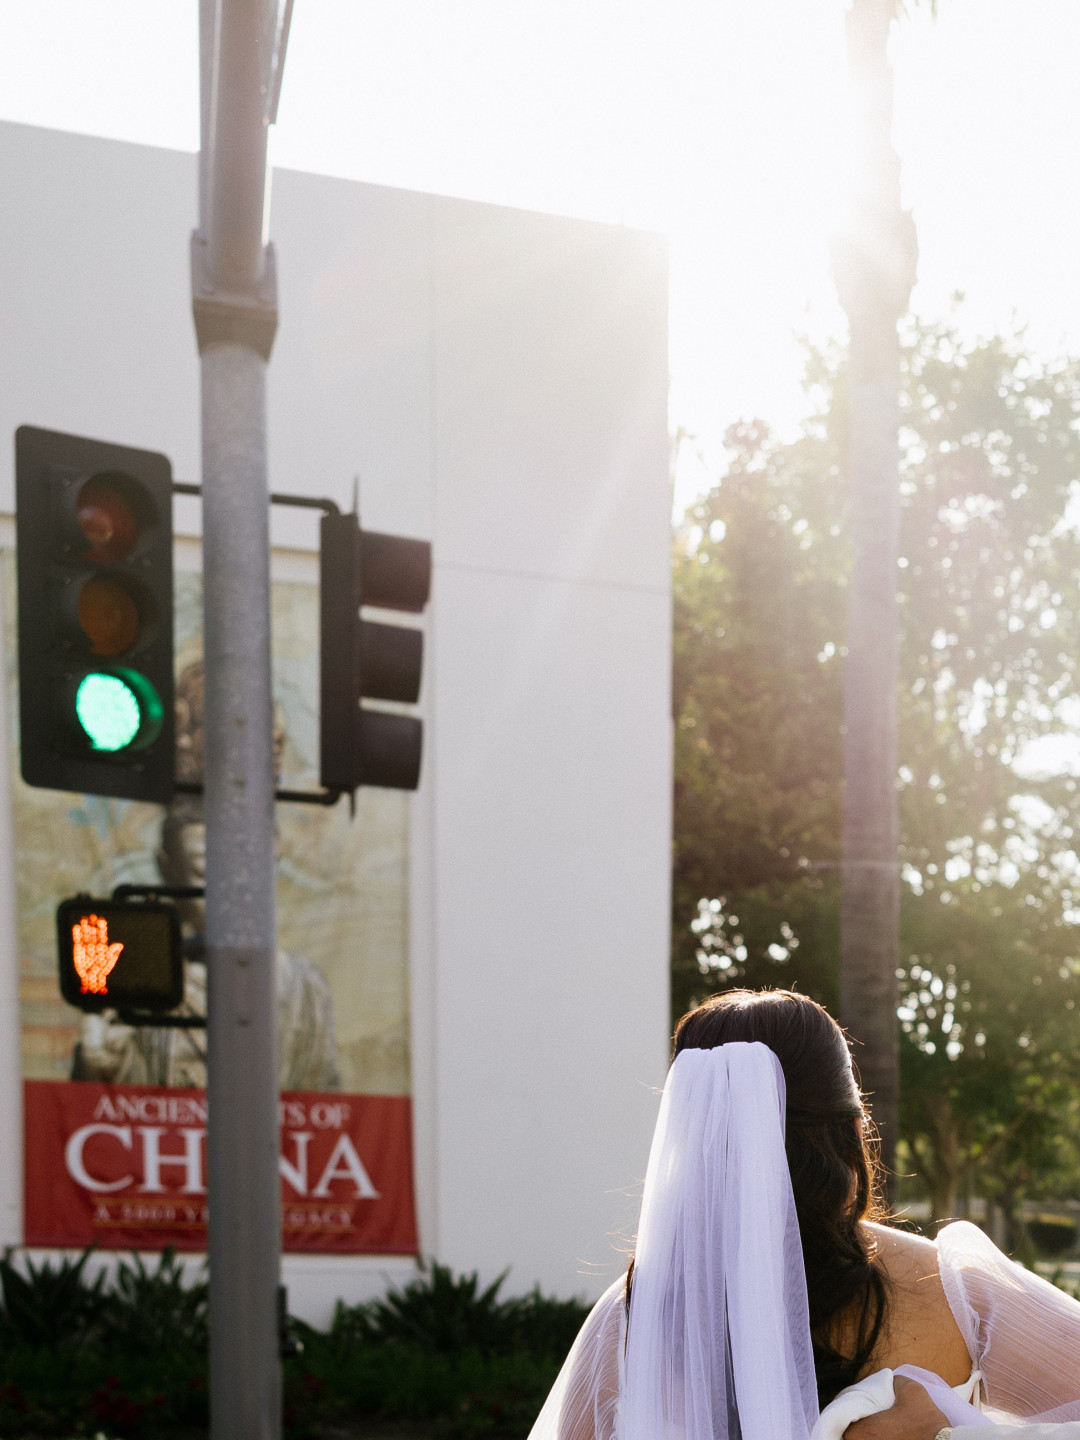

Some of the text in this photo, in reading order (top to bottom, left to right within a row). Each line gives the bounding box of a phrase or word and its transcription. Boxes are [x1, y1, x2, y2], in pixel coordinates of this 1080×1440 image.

[94, 1094, 208, 1123] ANCIEN
[310, 1102, 352, 1129] OF
[66, 1123, 381, 1200] CHNA
[95, 1203, 112, 1223] A
